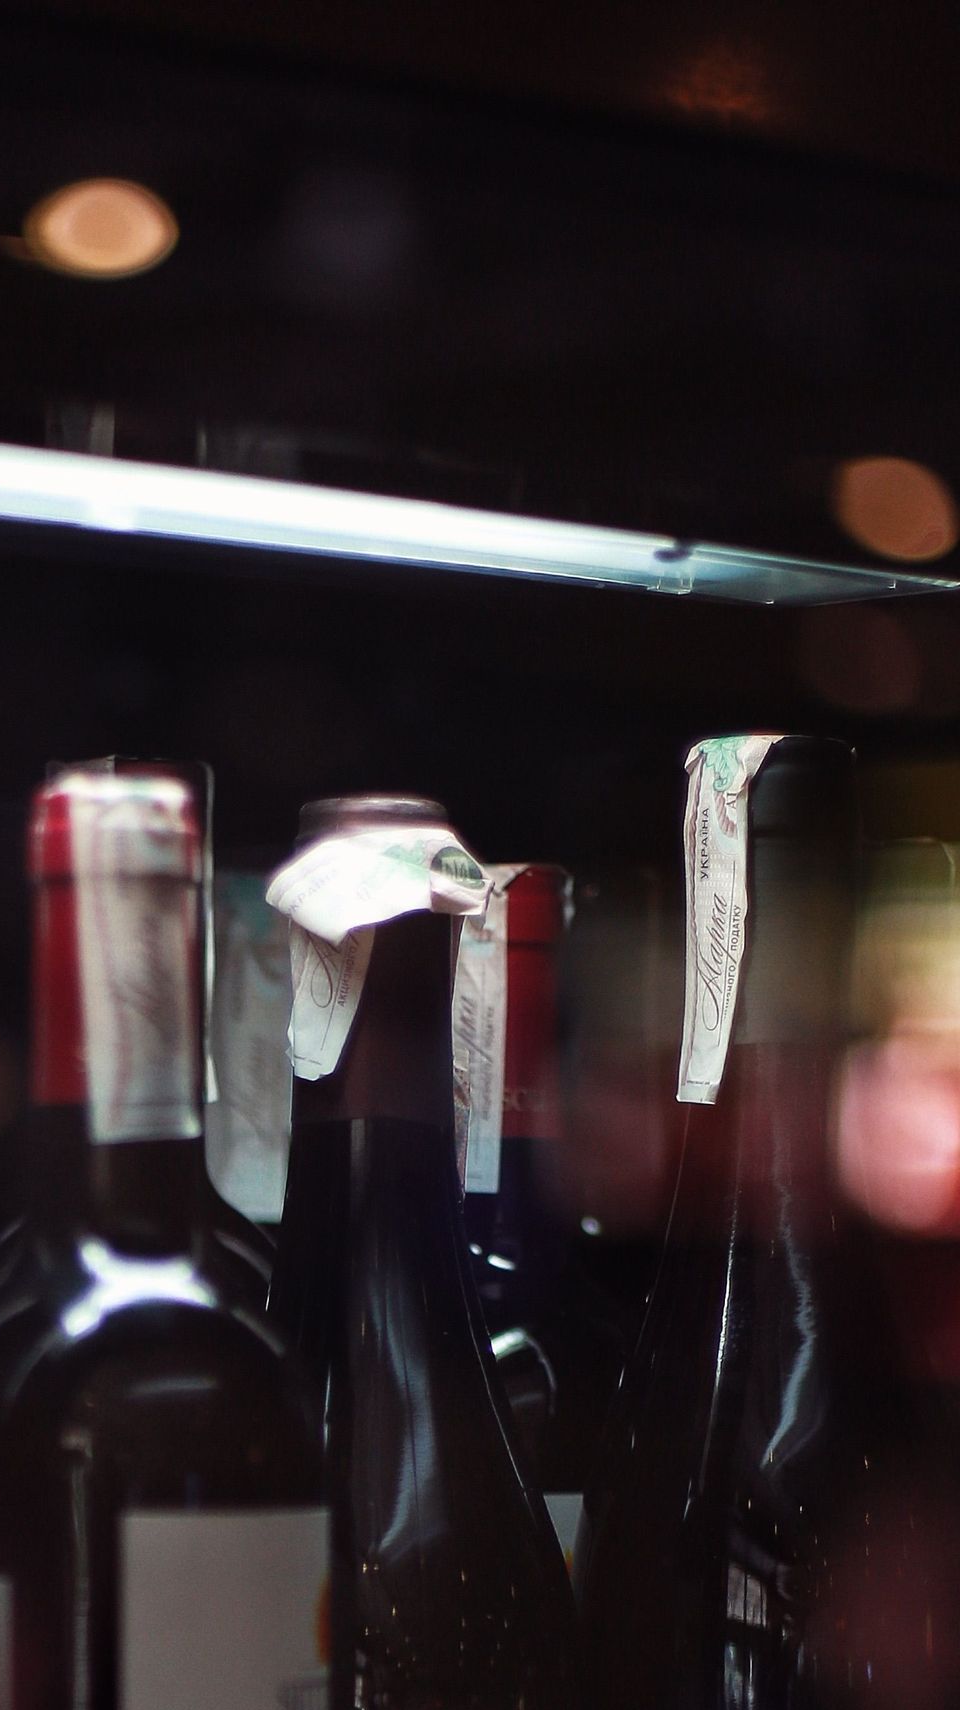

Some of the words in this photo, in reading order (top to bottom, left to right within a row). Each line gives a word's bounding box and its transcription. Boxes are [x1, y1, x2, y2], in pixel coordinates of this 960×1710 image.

[699, 806, 710, 880] УКРАЇНА
[698, 892, 739, 1031] Марка
[730, 903, 741, 952] ПОДАТКУ
